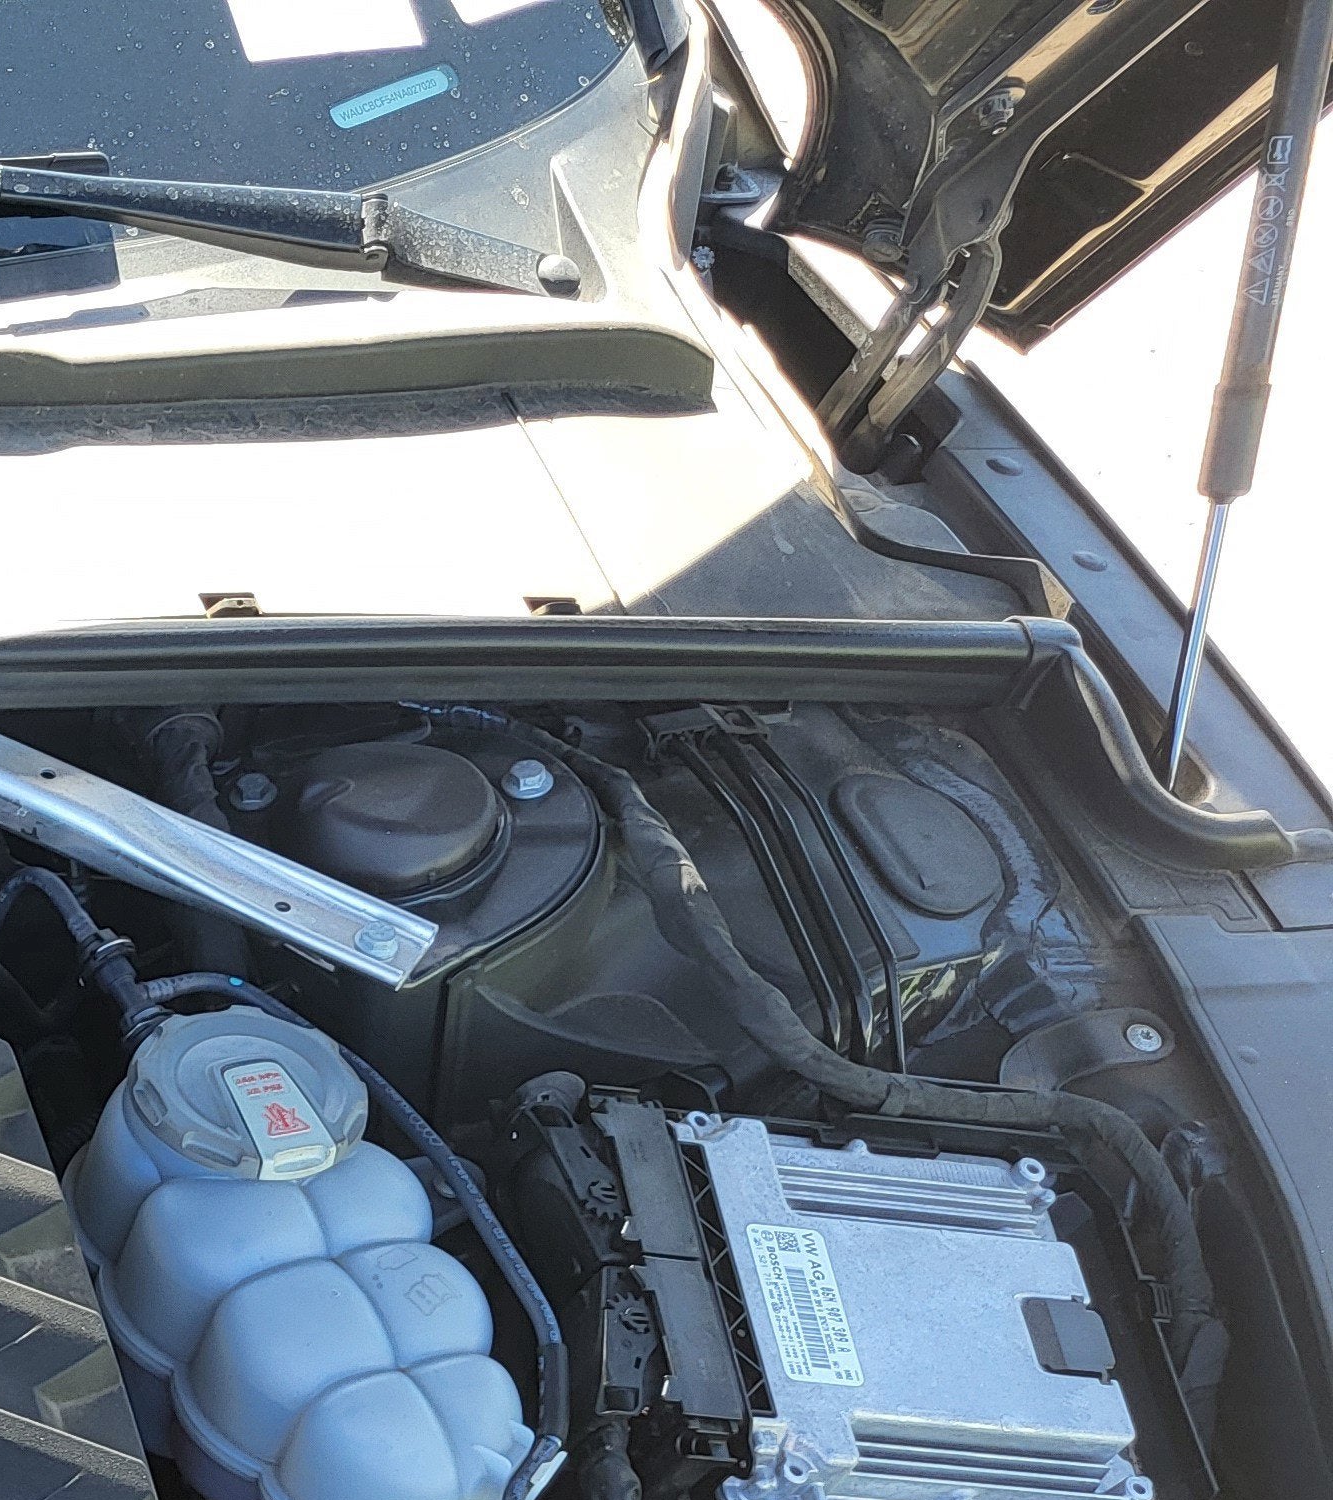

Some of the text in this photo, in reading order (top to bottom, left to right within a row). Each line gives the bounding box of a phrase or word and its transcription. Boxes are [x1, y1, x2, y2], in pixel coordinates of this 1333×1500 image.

[338, 78, 438, 122] WAUCBCF54NA027020
[800, 1232, 818, 1256] VW
[766, 1245, 783, 1280] BOSCH
[808, 1259, 825, 1280] AG
